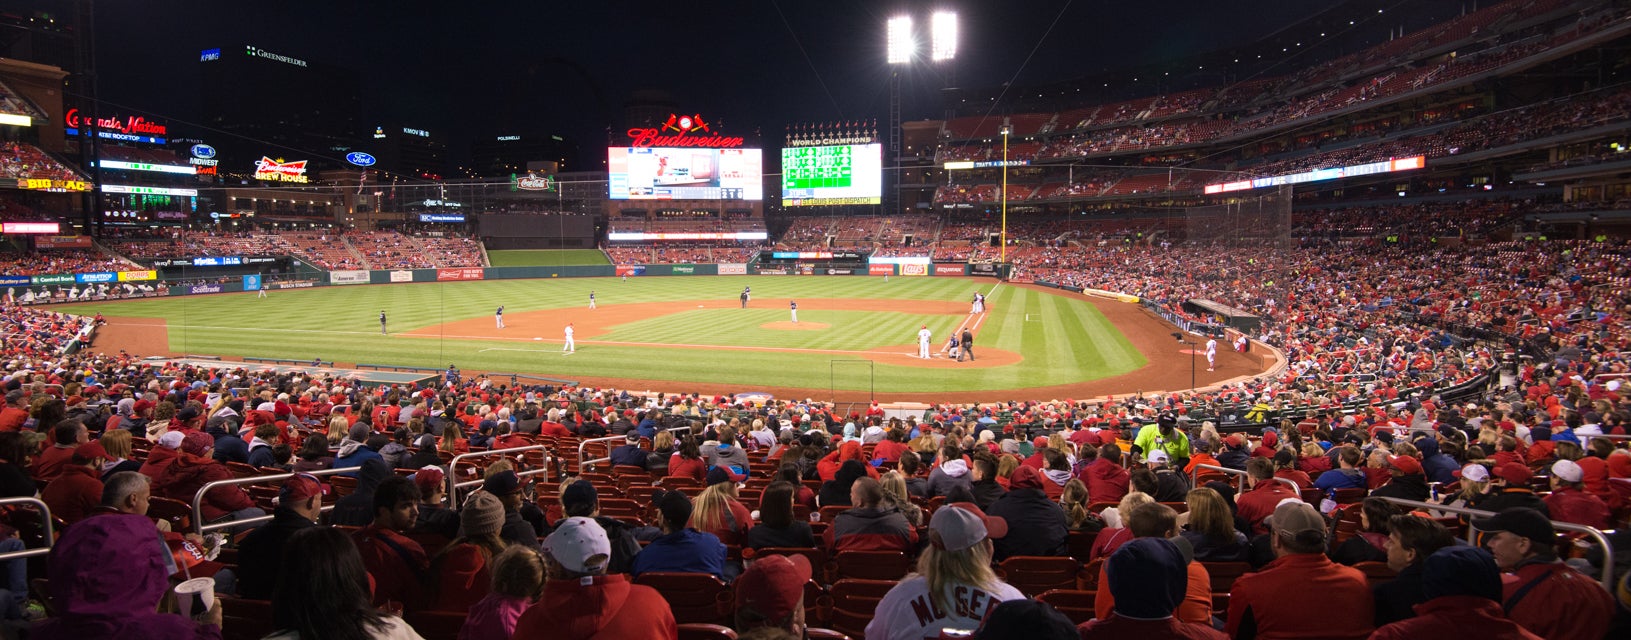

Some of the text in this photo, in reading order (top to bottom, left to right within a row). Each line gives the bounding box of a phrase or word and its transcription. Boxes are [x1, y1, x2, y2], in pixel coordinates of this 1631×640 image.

[201, 52, 219, 62] KPMG
[257, 49, 307, 67] GREENSFELDER
[66, 108, 167, 135] Carnals Nation
[112, 132, 140, 141] ROOFTOP
[403, 127, 419, 135] KMOV
[627, 127, 744, 148] Budweiser
[822, 136, 872, 145] CHAMPIONS
[189, 157, 219, 166] MIDWEST
[353, 153, 371, 164] Ford
[255, 160, 307, 175] Budweiser
[255, 172, 308, 183] BREW HOUSE
[27, 178, 85, 191] BIG MAC
[191, 284, 221, 294] Scottrade
[910, 585, 1001, 628] MUGE
